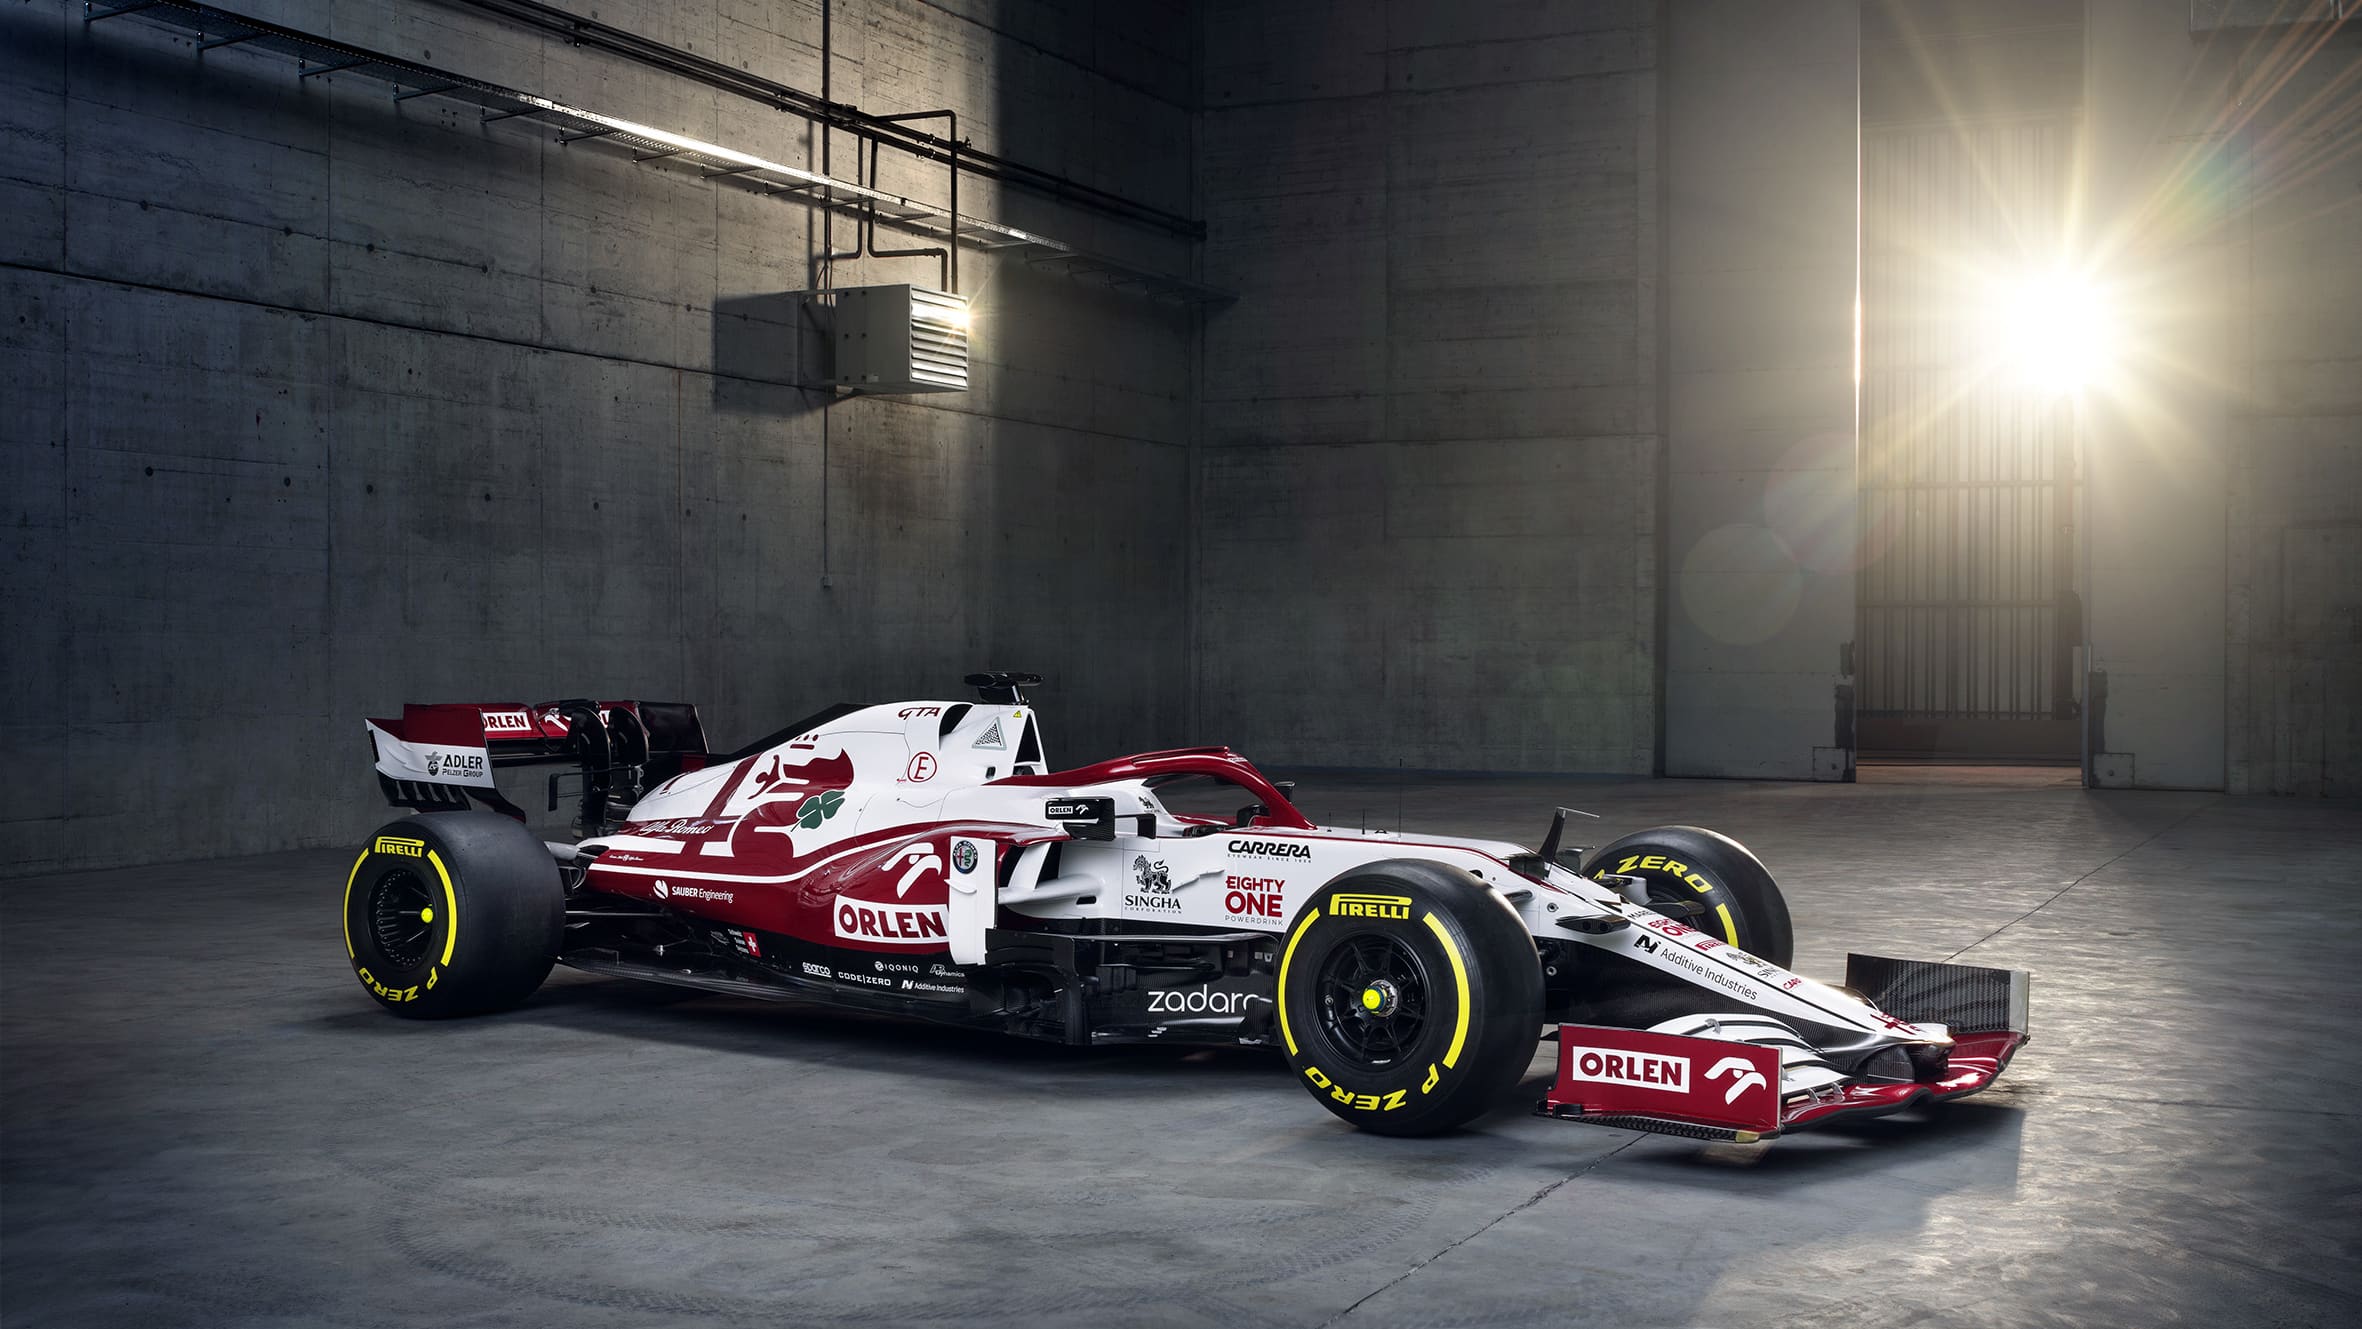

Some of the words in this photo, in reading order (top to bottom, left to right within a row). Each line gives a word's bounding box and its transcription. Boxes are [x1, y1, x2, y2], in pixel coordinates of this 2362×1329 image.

[898, 706, 941, 720] GTA
[443, 754, 483, 770] ADLER
[1049, 806, 1073, 814] ORLEN
[638, 820, 665, 835] Alfa
[668, 819, 714, 834] Romeo
[374, 836, 424, 858] PIRELLI
[1228, 840, 1311, 859] CARRERA
[1225, 875, 1285, 893] EIGHTY
[1616, 855, 1713, 894] ZERO
[671, 886, 698, 898] SAUBER
[699, 888, 734, 903] Engineering
[1125, 895, 1182, 909] SINGHA
[1225, 890, 1283, 917] ONE
[1329, 893, 1413, 920] PIRELLI
[838, 904, 948, 938] ORLEN
[1225, 914, 1284, 926] POWERDRINK
[802, 962, 831, 976] sparco
[884, 963, 919, 973] IQONIQ
[1660, 947, 1704, 976] Additive
[1704, 967, 1759, 1001] Industries
[358, 967, 418, 1002] ZERO
[426, 966, 439, 990] P
[914, 982, 936, 991] Additive
[936, 984, 965, 993] Industries
[1421, 1063, 1440, 1095] P
[1579, 1052, 1682, 1087] ORLEN
[1304, 1066, 1407, 1111] ZERO
